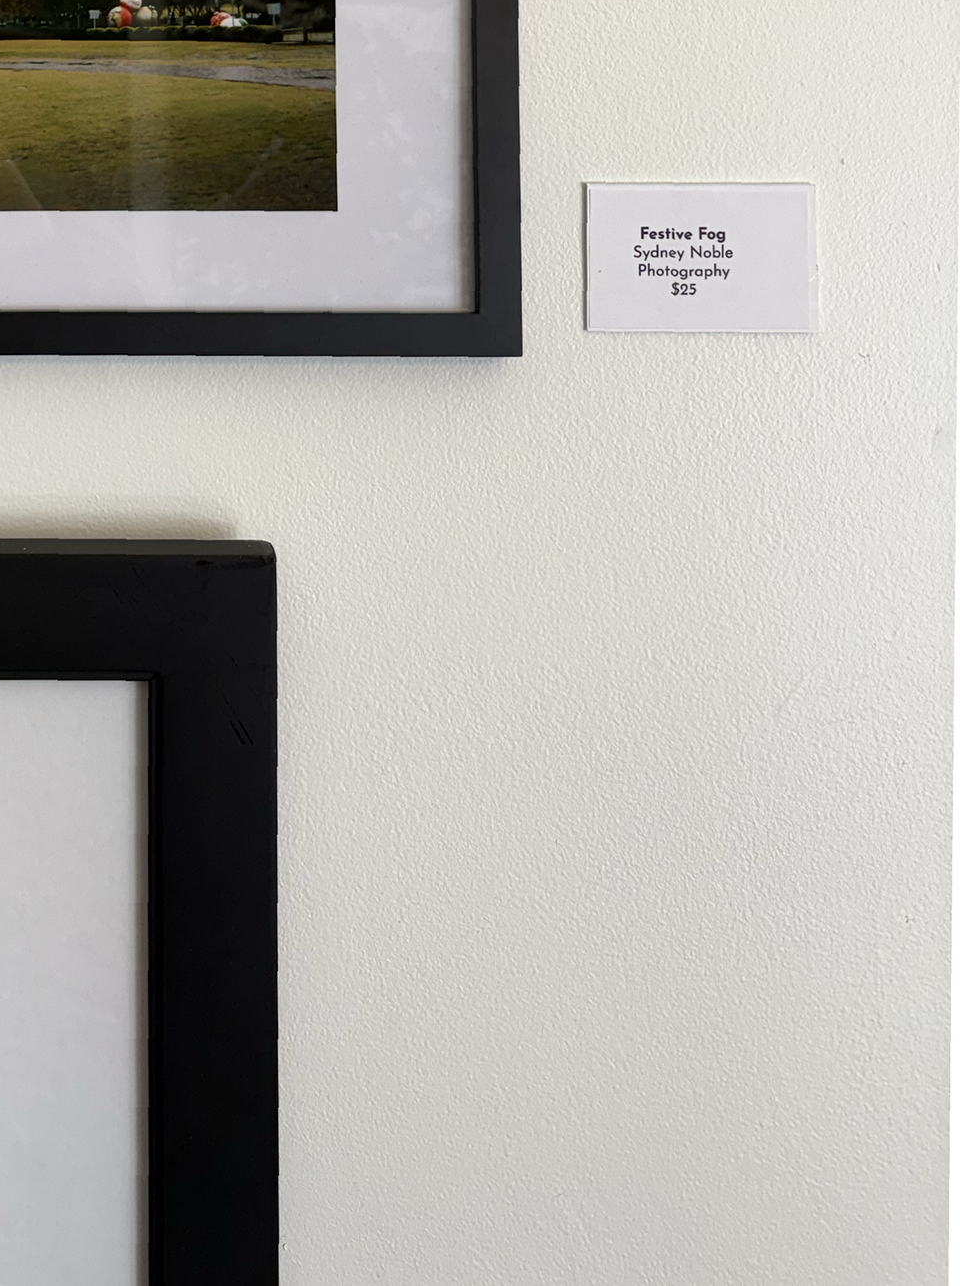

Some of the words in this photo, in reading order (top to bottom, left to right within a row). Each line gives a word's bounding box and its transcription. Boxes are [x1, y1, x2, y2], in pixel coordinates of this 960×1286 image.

[640, 227, 693, 240] Festive
[698, 227, 726, 243] Fog
[633, 244, 685, 261] Sydney
[690, 244, 734, 259] Noble
[638, 263, 730, 280] Photography
[670, 282, 697, 296] $25
